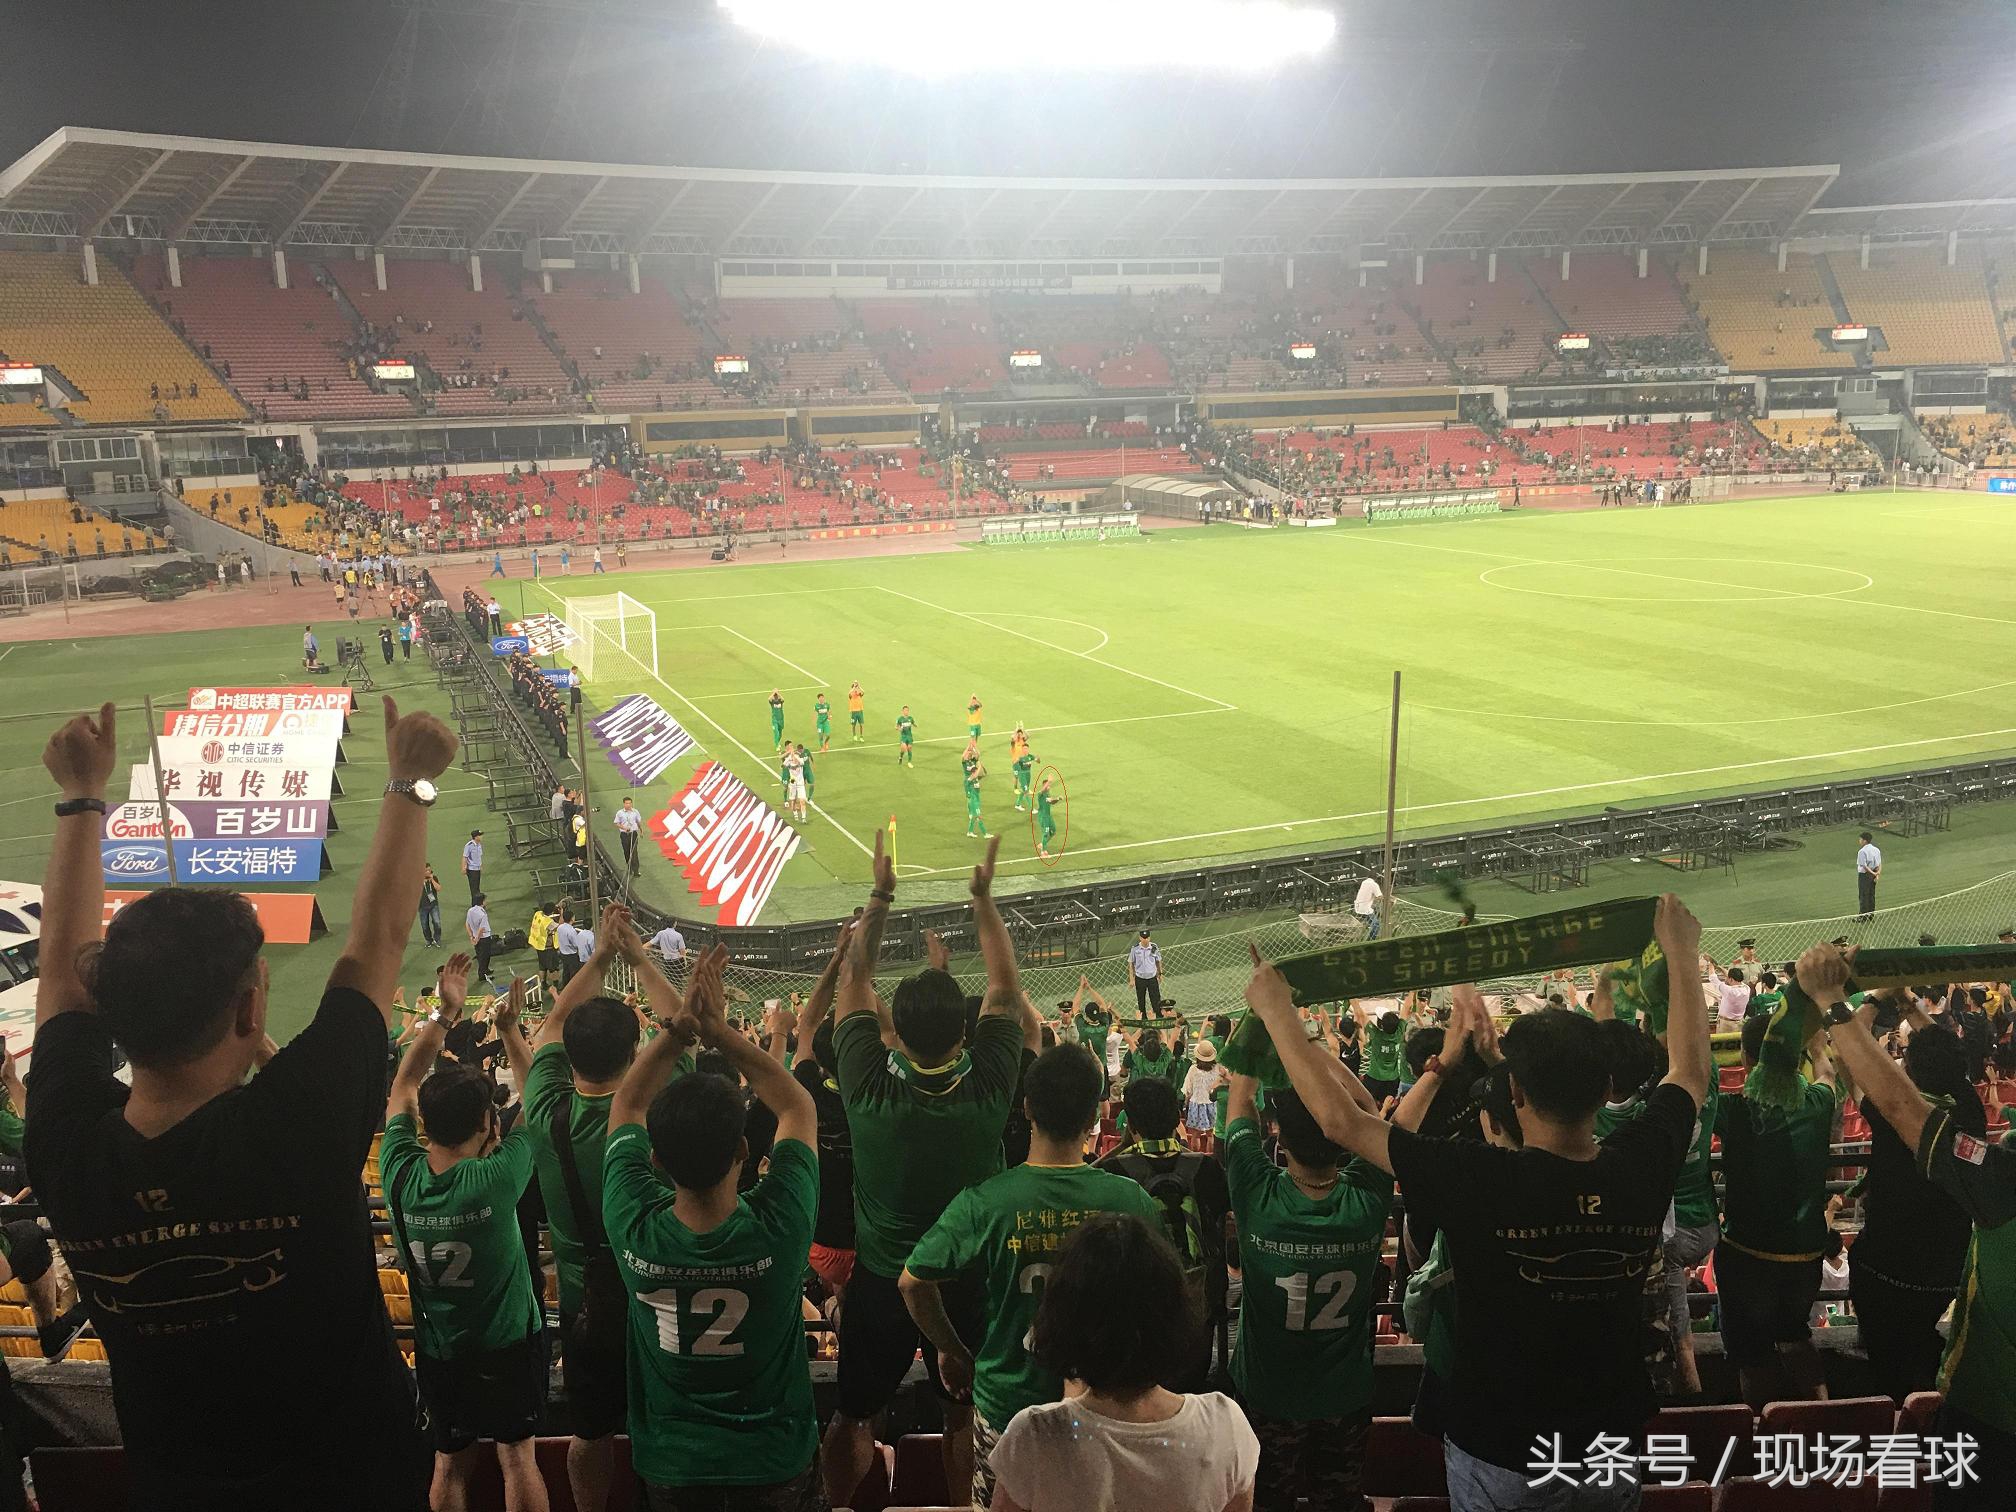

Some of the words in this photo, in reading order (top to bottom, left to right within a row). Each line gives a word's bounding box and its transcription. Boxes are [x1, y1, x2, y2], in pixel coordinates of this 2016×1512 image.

[217, 693, 349, 710] 中超联赛官方APP
[227, 742, 285, 755] 中信证券
[227, 756, 244, 764] CITIC
[246, 756, 283, 764] SECURITIES
[155, 769, 309, 798] 华视传媒
[216, 807, 317, 835] 百岁山
[111, 851, 158, 871] Ford
[188, 847, 297, 875] 长安福特
[1392, 947, 1533, 982] SPEEDY
[134, 1188, 175, 1213] 12
[1576, 1193, 1602, 1216] 12
[208, 1215, 301, 1235] SPEEDY
[409, 1240, 475, 1288] 12
[622, 1249, 773, 1276] 北京国安足球俱乐部
[1275, 1270, 1357, 1331] 12
[636, 1288, 750, 1356] 12
